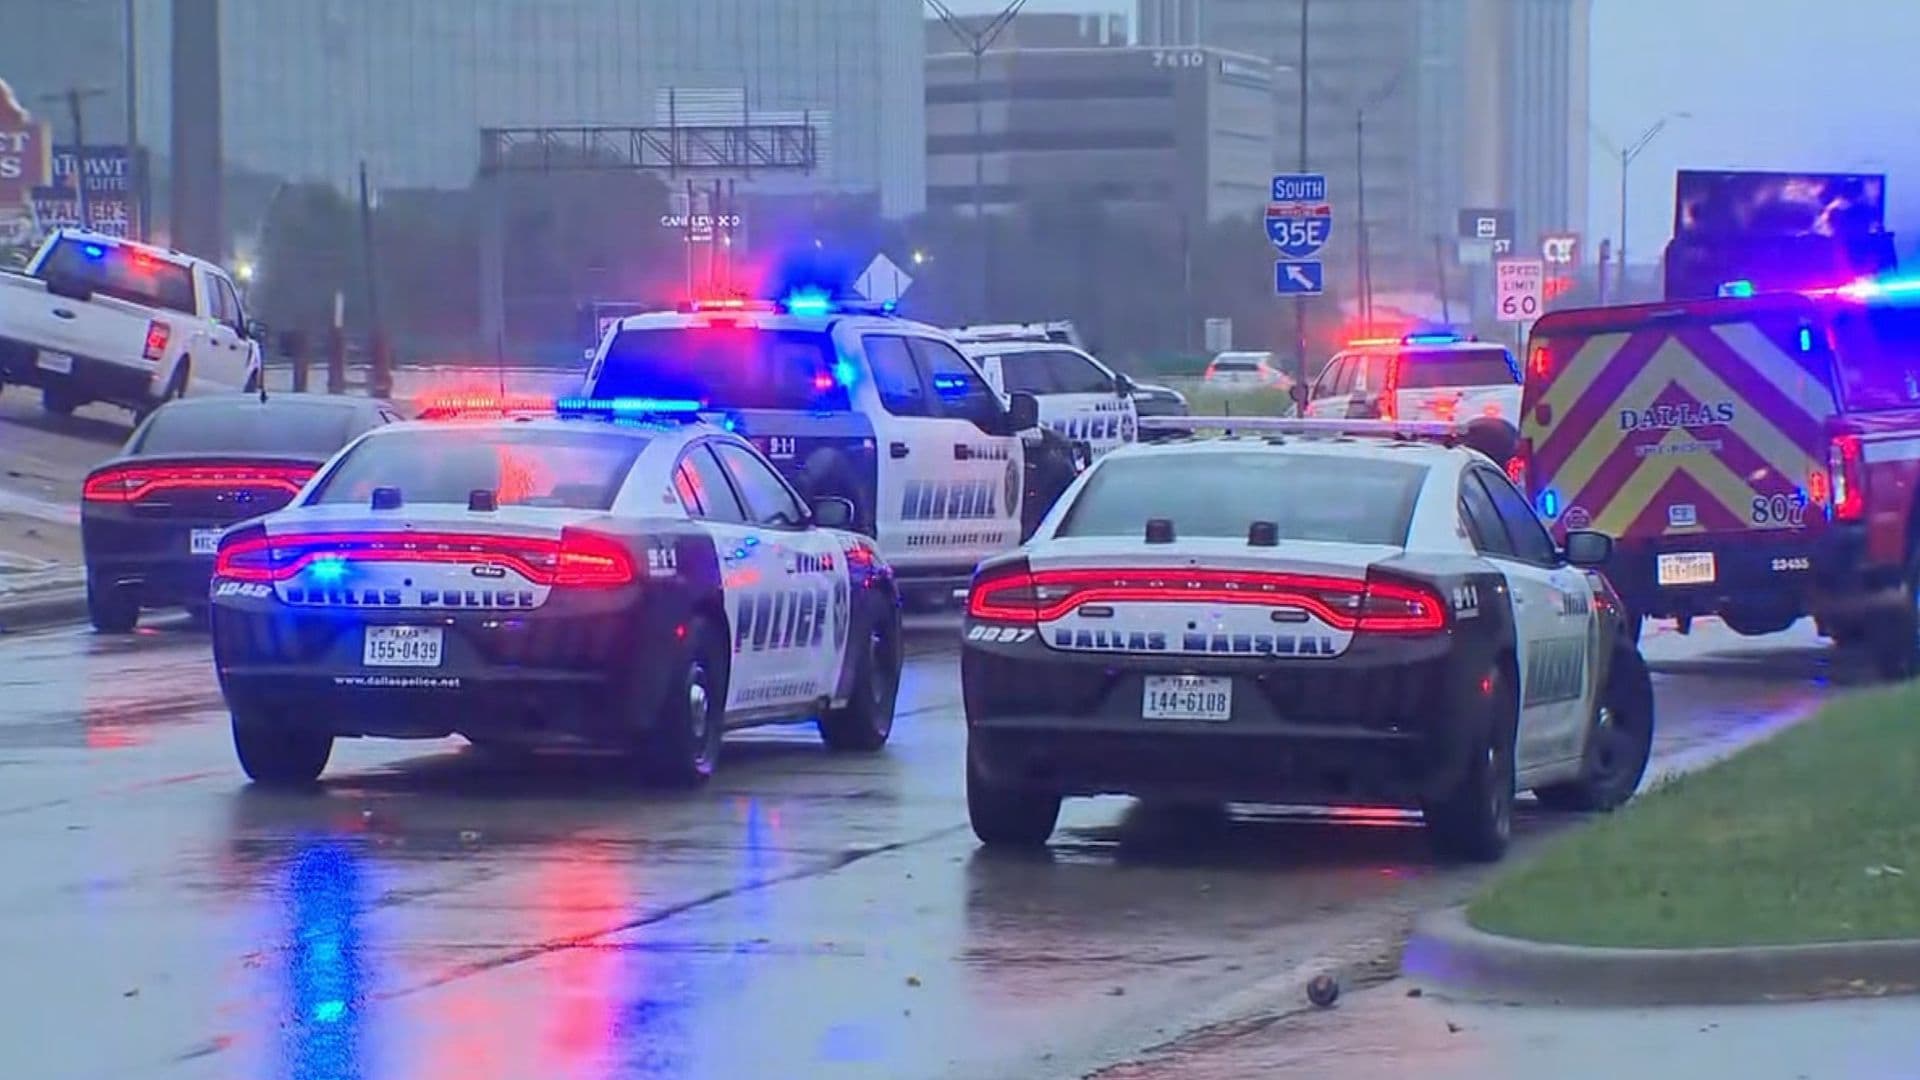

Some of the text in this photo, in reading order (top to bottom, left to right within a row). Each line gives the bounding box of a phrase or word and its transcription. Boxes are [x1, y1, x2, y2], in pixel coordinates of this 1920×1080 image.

[1275, 179, 1322, 199] SOUTH
[1273, 221, 1323, 246] 35E
[1500, 264, 1540, 277] SPEED
[1504, 280, 1536, 292] LIMIT
[1502, 295, 1537, 315] 60
[1618, 402, 1735, 431] DALLAS
[1750, 493, 1808, 527] 807
[286, 588, 533, 607] DALLAS POLICE
[733, 588, 829, 653] POLICE
[1054, 628, 1336, 656] DALLAS MARSHAL
[334, 675, 461, 688] www.dallaspolice.net
